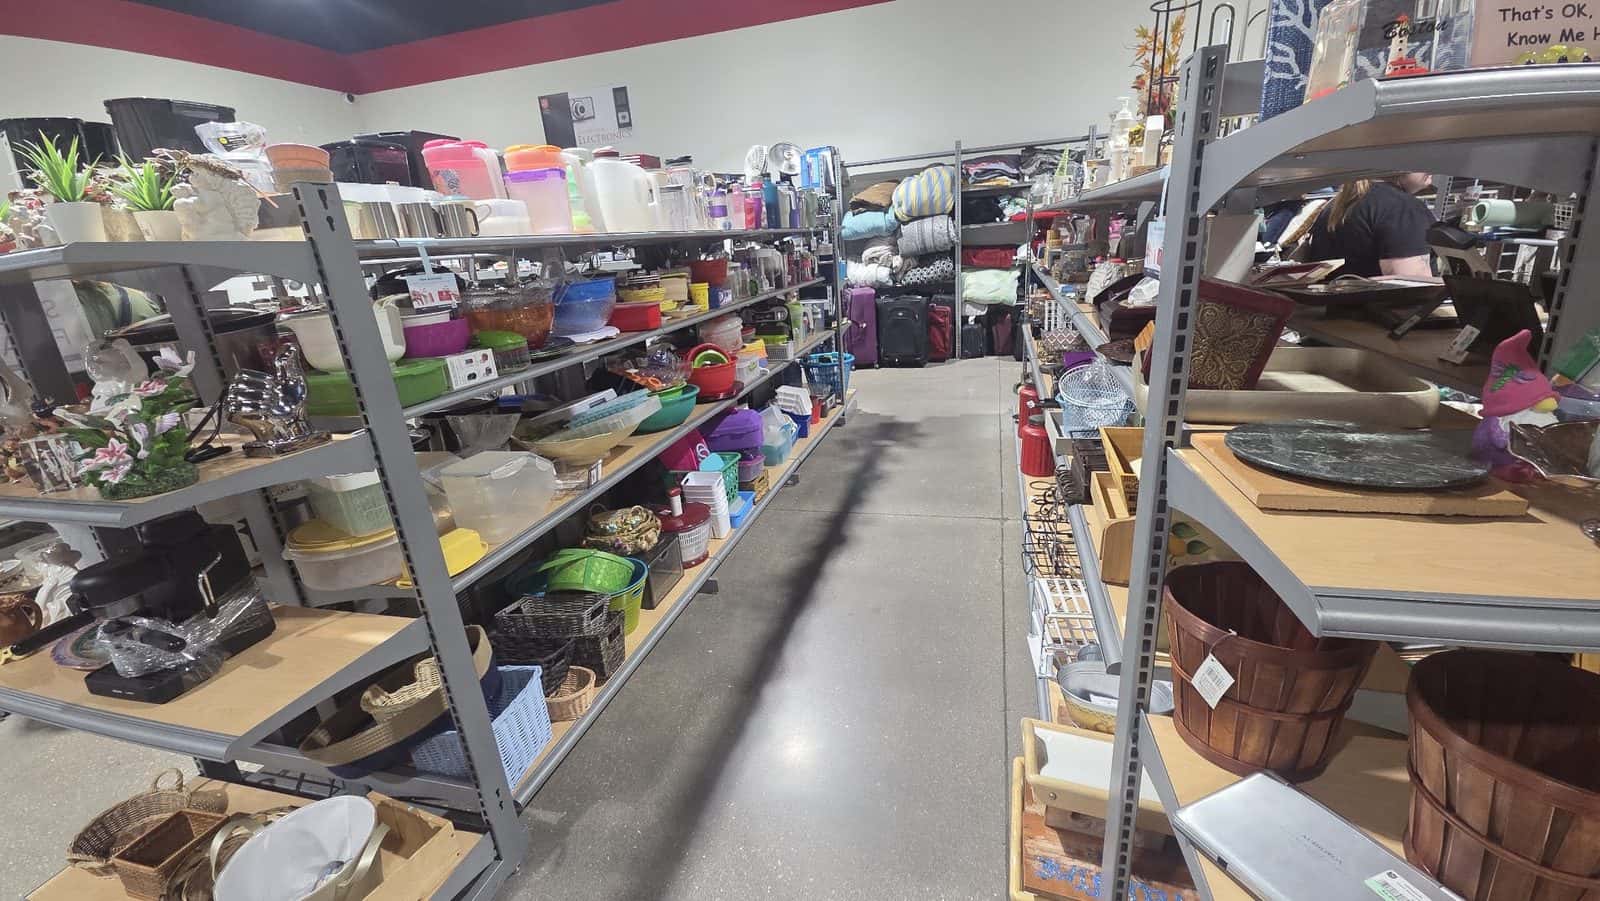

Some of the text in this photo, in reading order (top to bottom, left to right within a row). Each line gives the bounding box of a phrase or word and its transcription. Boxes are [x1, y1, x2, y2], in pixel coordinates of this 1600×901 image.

[1498, 3, 1593, 22] That's OK,
[1507, 31, 1552, 47] Know
[1560, 27, 1585, 43] Me
